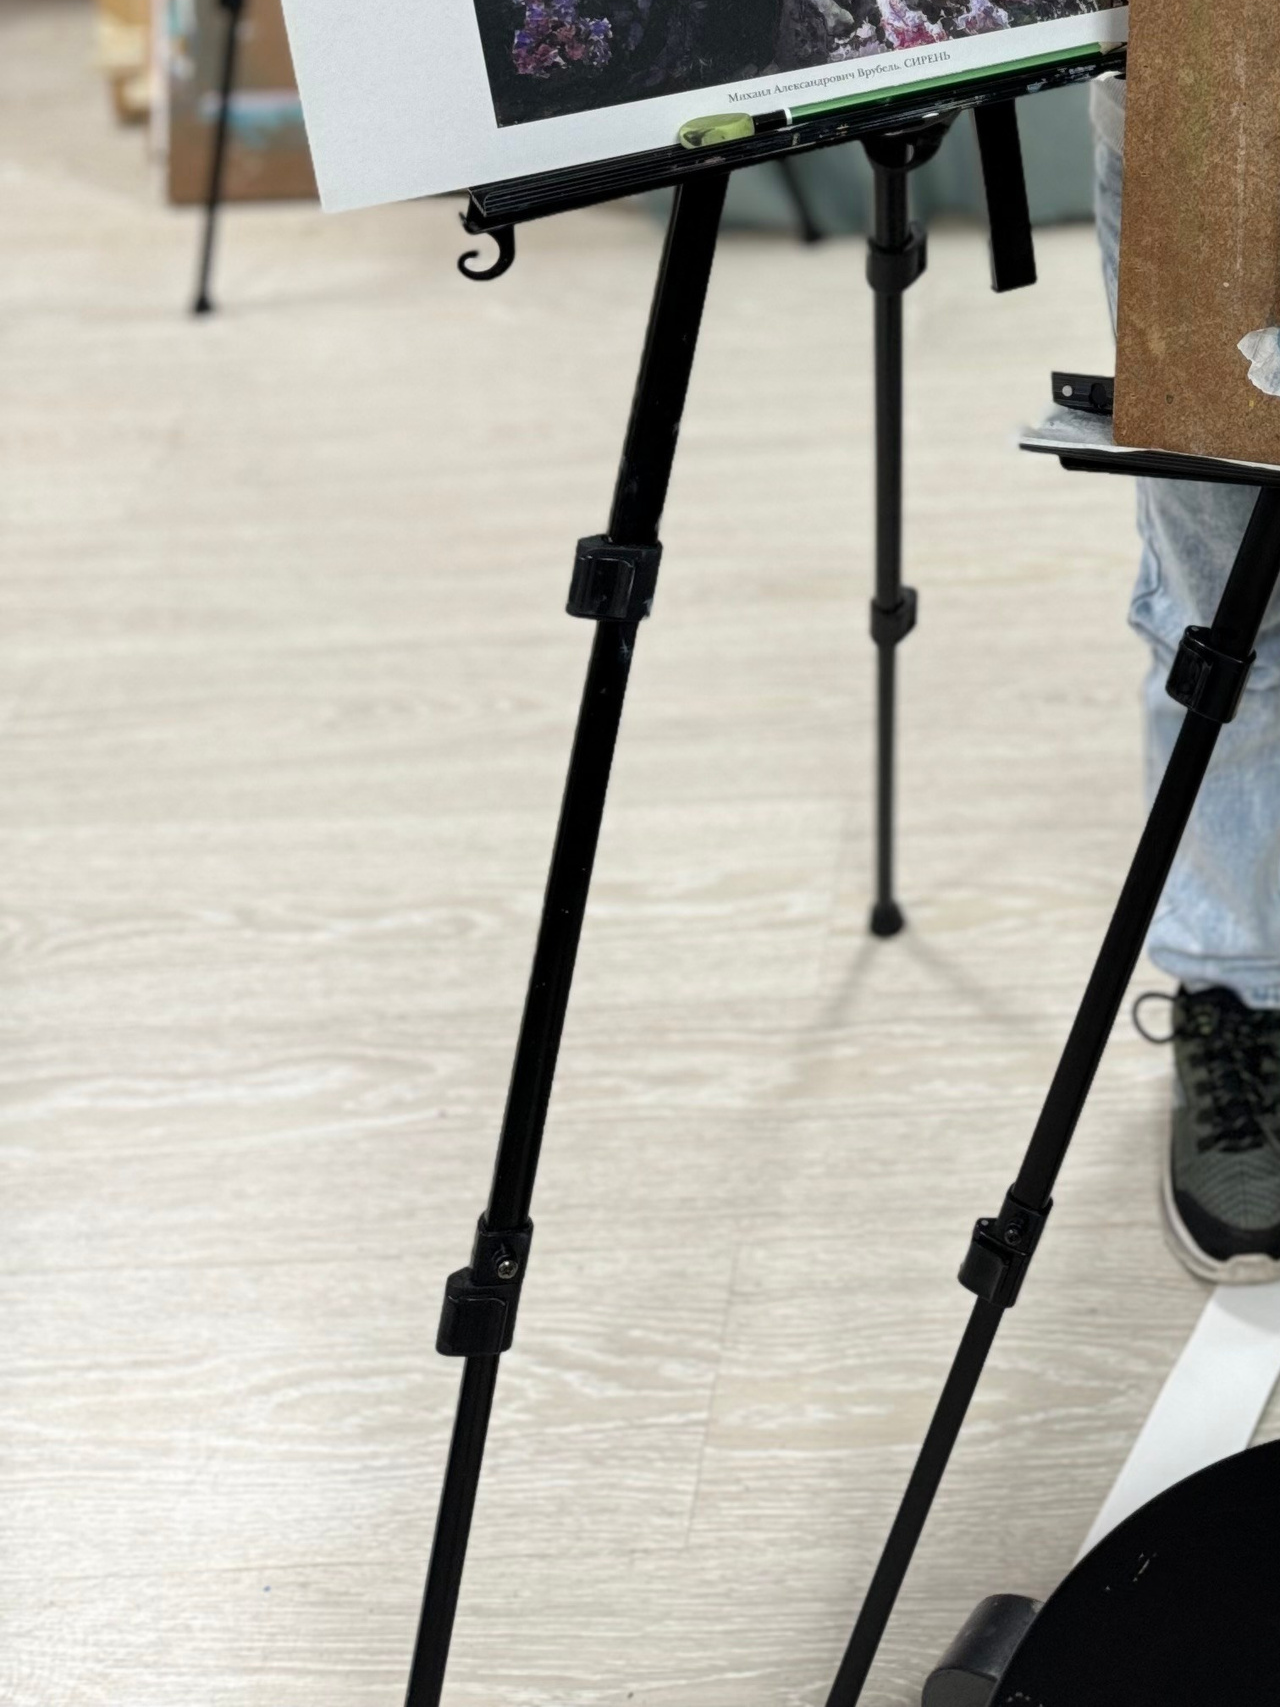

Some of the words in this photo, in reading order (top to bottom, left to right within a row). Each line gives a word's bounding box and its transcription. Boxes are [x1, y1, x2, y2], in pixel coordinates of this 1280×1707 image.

[728, 88, 771, 104] Михаил
[774, 71, 855, 94] Александрович
[903, 51, 951, 69] СИРЕНЬ
